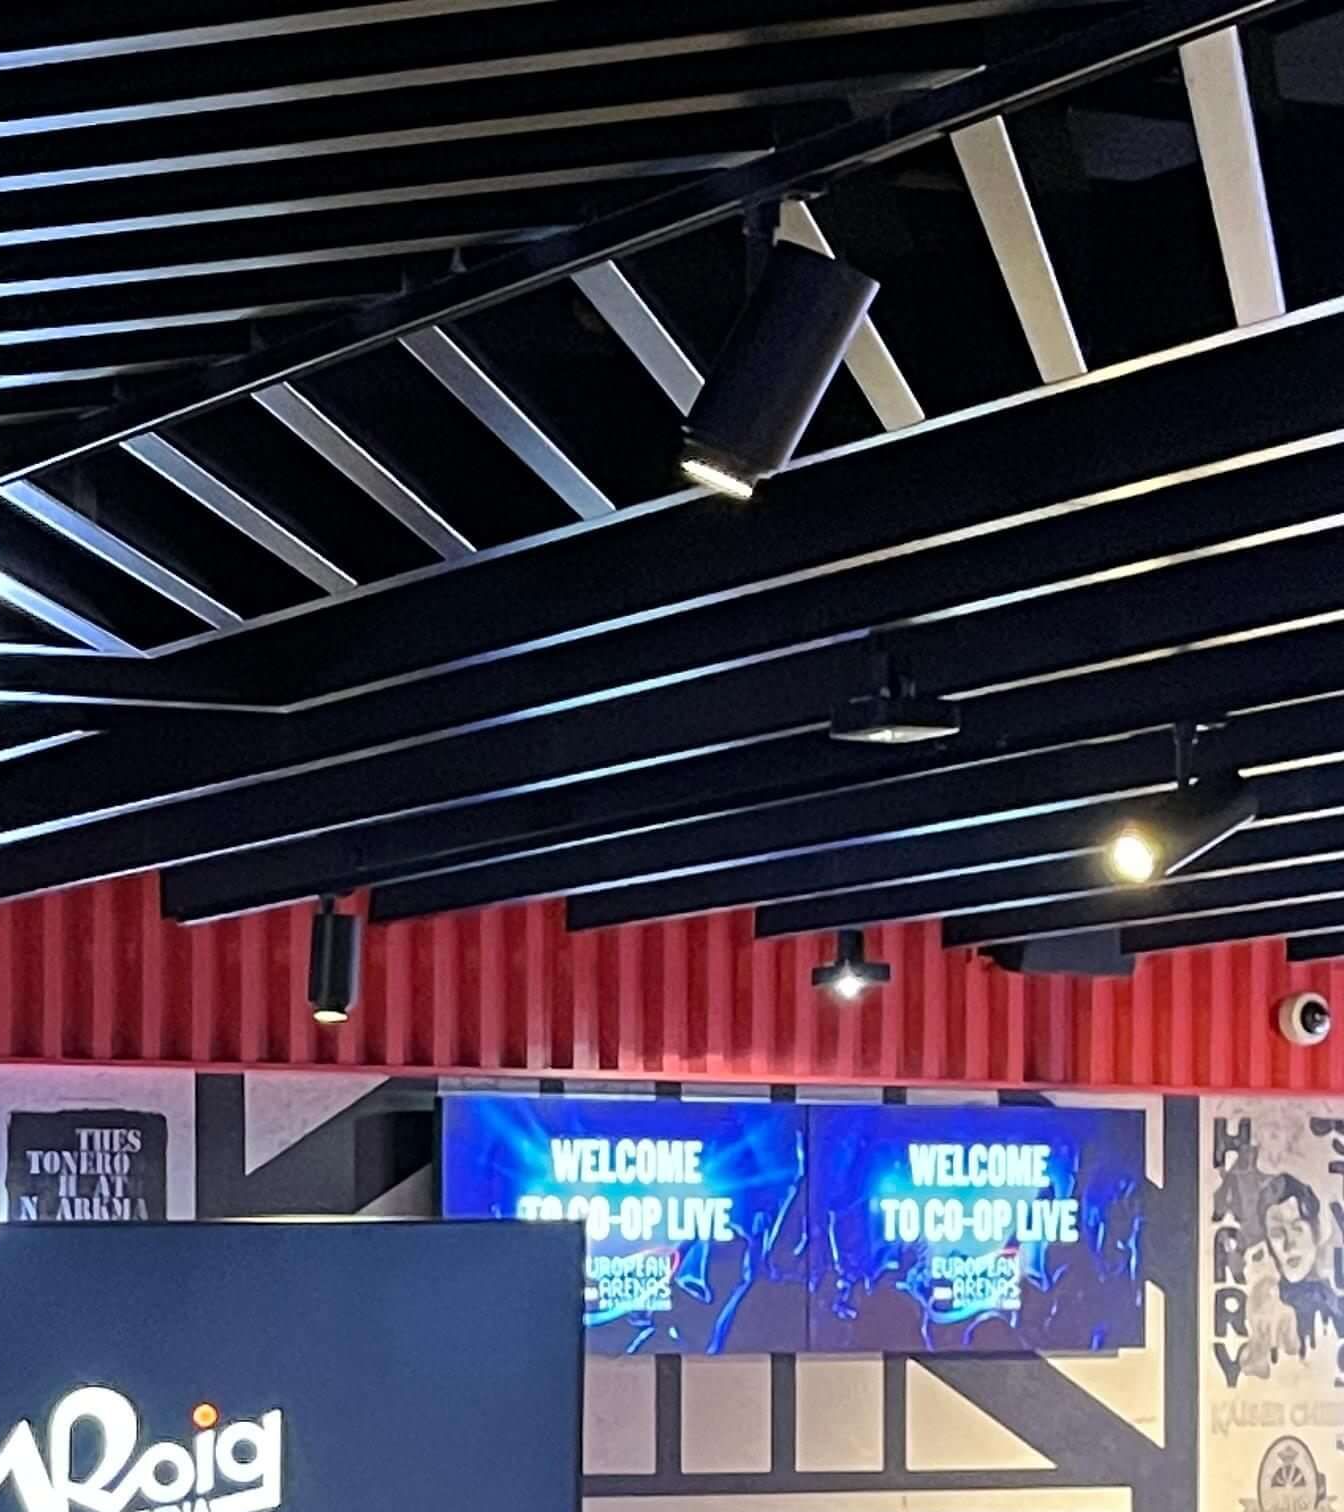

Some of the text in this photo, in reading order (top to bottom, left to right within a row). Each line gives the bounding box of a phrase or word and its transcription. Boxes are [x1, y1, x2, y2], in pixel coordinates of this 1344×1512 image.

[550, 1138, 704, 1184] WELCOME
[909, 1143, 1052, 1188] WELCOME
[667, 1197, 735, 1242] LIVE
[880, 1199, 1080, 1243] TO CO-OP LIVE
[586, 1255, 671, 1279] UROPEAN
